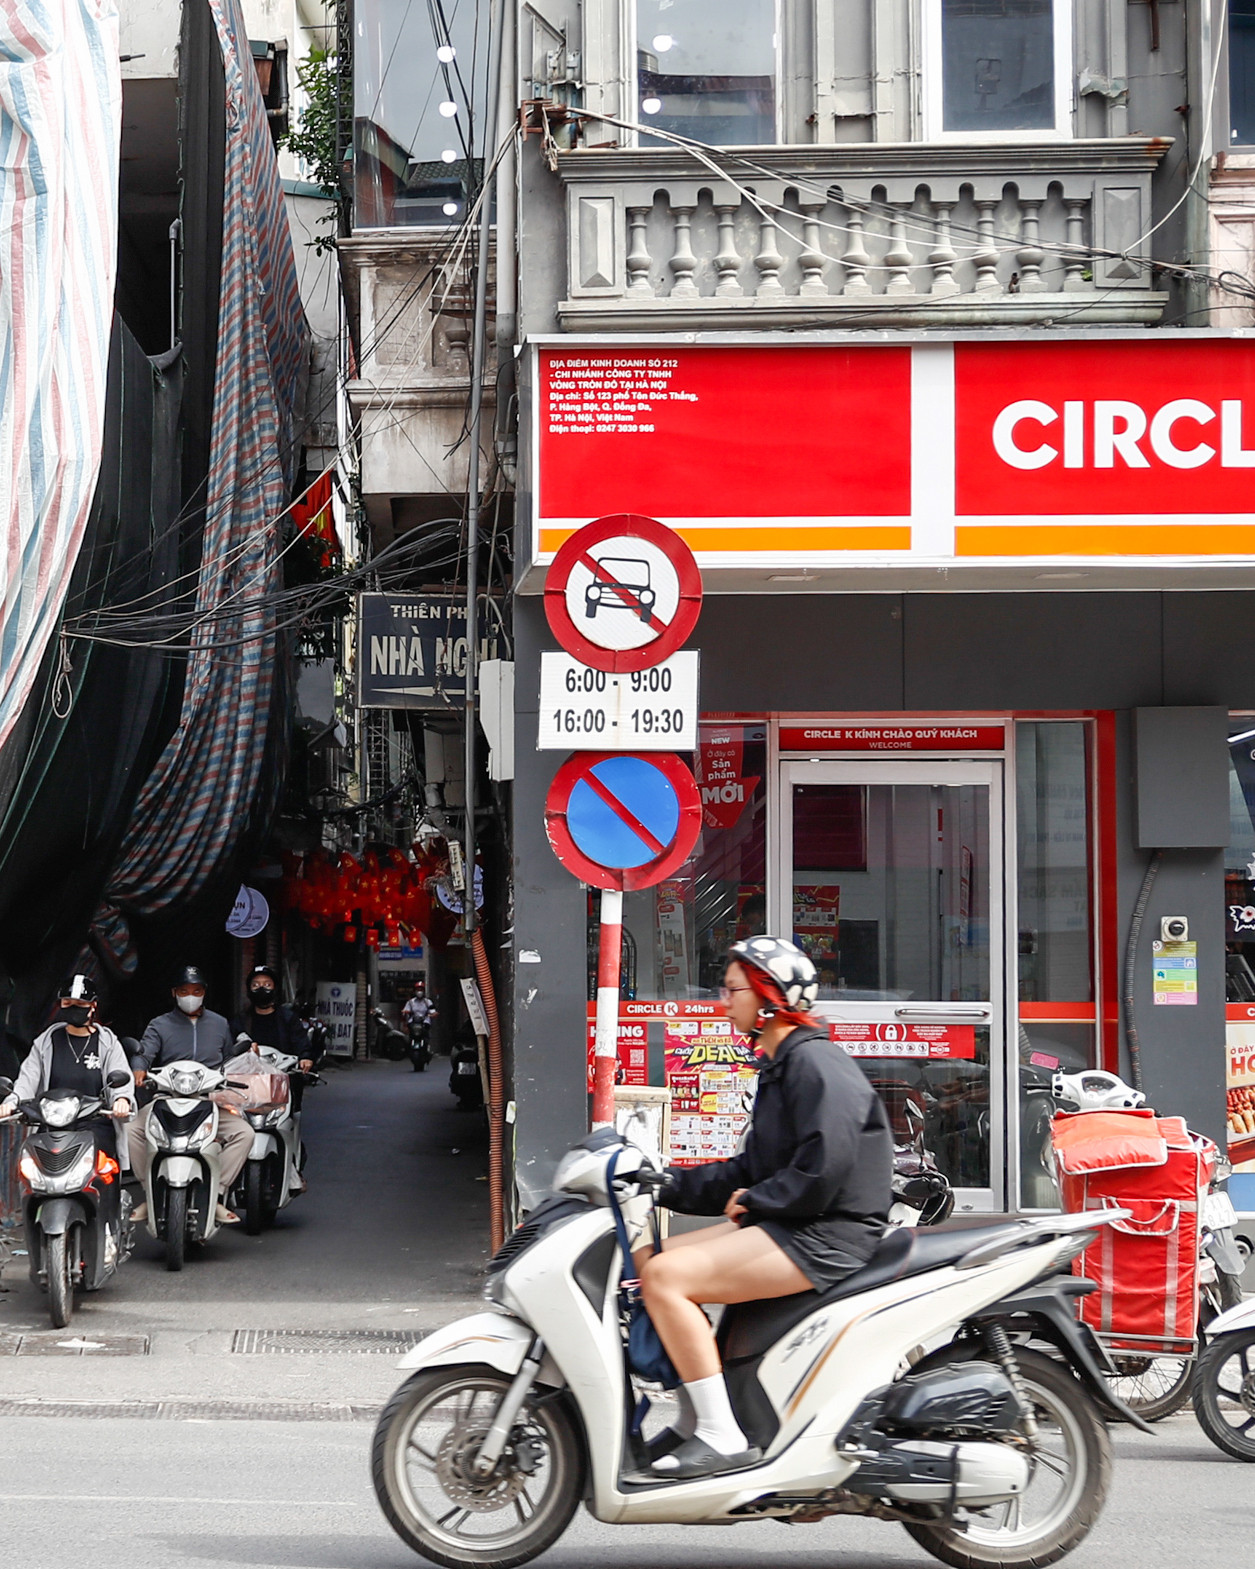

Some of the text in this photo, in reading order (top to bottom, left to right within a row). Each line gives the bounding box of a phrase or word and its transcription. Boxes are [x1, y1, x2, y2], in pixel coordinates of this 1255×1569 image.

[590, 360, 612, 368] KINH
[613, 360, 646, 368] DOANH
[662, 360, 678, 368] 212
[596, 392, 612, 400] 123
[549, 414, 563, 422] TP.
[614, 414, 634, 422] Nam
[371, 625, 425, 676] NHÀ
[565, 668, 606, 692] 6:00
[630, 667, 672, 692] 9:00
[553, 708, 606, 733] 16:00
[631, 708, 684, 733] 19:30
[803, 727, 977, 739] CIRCLE K KÍNH CHÀO QUÝ KHÁCH
[711, 737, 731, 745] NEW
[868, 741, 912, 749] WELCOME
[712, 758, 731, 769] Sản
[701, 780, 744, 805] MỚI
[626, 1004, 662, 1014] CIRCLE
[684, 1004, 715, 1014] 24hrs
[590, 1025, 644, 1038] HING
[687, 1045, 747, 1065] DEAL
